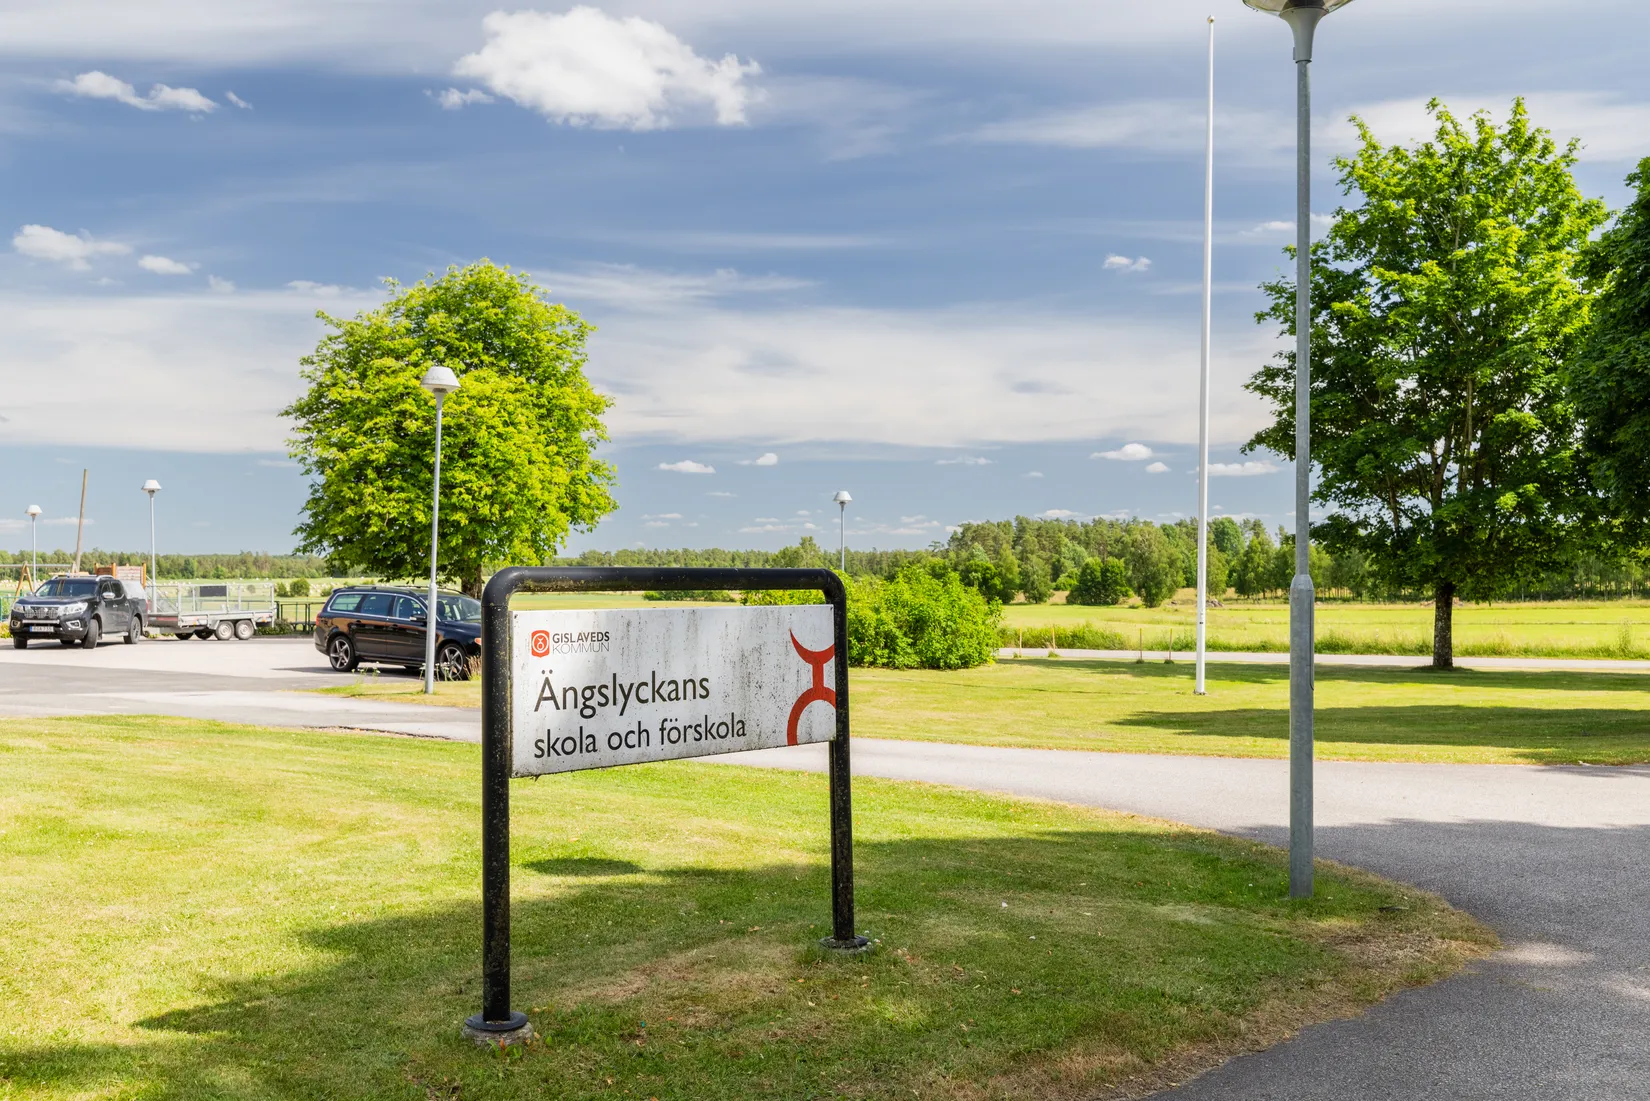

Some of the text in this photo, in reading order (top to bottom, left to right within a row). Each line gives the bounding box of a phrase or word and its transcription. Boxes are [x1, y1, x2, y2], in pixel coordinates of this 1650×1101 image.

[552, 631, 610, 644] GISLAVEDS
[552, 642, 610, 654] KOMMUN
[534, 669, 710, 719] Ängslyckans
[534, 712, 747, 758] skola och förskola
